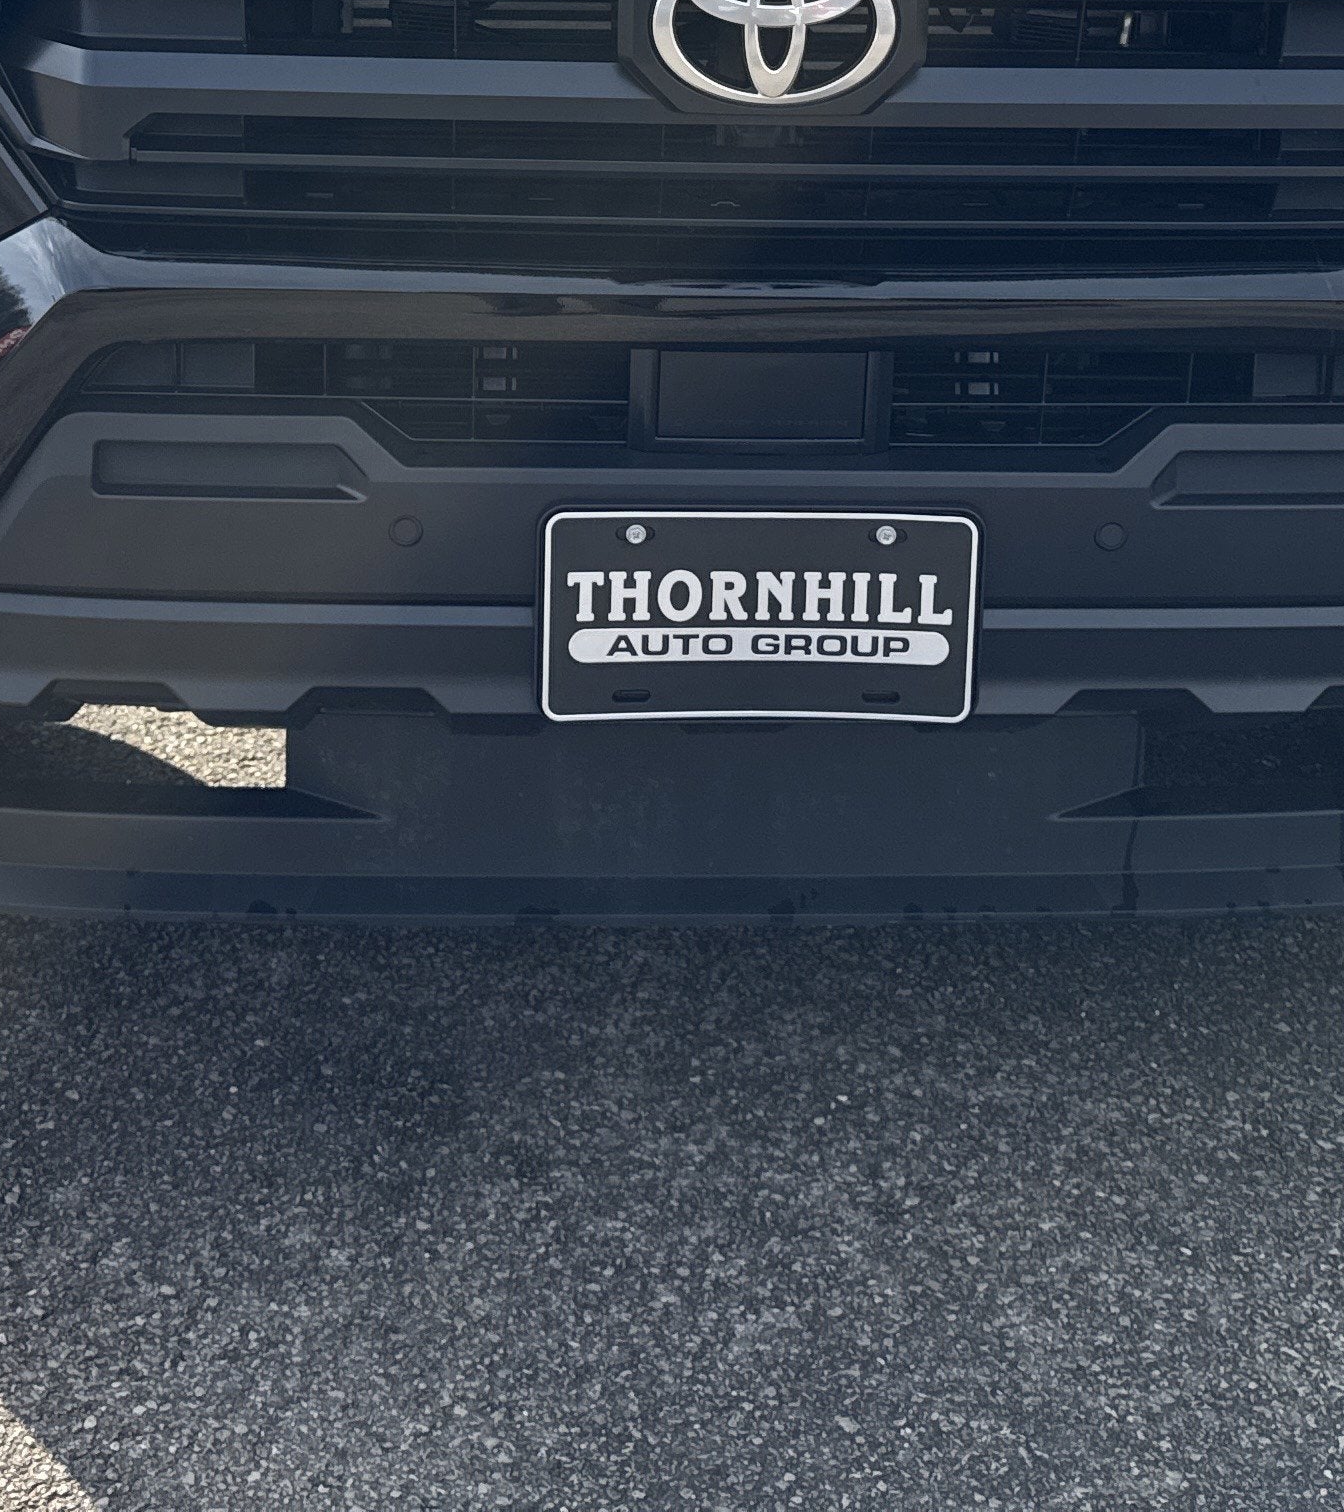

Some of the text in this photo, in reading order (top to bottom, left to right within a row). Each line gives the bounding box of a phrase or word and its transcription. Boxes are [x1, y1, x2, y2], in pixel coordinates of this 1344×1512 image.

[567, 569, 953, 626] THORNHILL
[606, 633, 911, 658] AUTO GROUP
